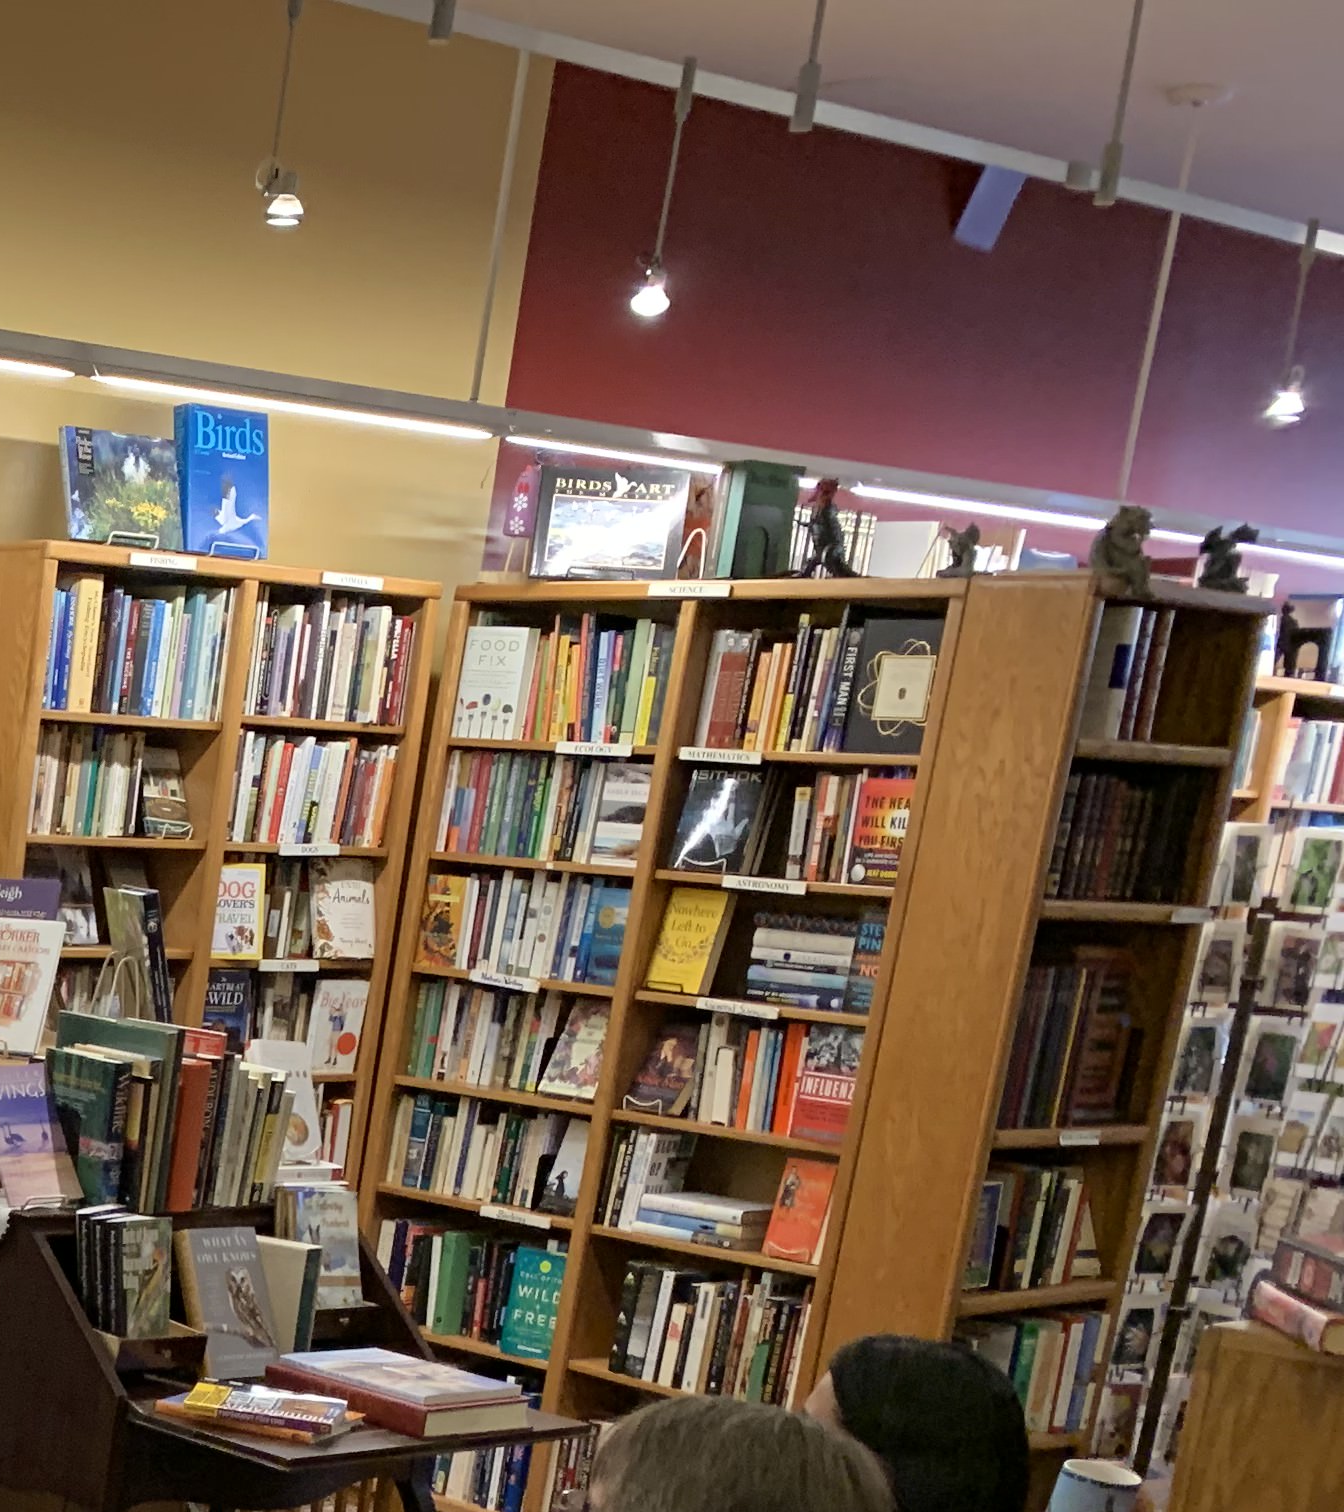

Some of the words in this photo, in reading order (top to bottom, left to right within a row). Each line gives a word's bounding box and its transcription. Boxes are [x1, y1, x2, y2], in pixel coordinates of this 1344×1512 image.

[194, 411, 265, 457] Birds
[554, 477, 612, 493] BIRDS
[635, 482, 675, 497] ART
[469, 639, 520, 652] FOOD
[477, 655, 507, 667] FIX
[843, 647, 858, 677] FIRST
[836, 681, 851, 706] MAN
[574, 744, 612, 754] ECOLOGY
[687, 750, 751, 762] MATHEMATICS
[865, 796, 883, 809] THE
[886, 797, 911, 810] HEA
[861, 815, 883, 828] WILL
[886, 815, 907, 828] KIL
[881, 835, 905, 847] FIRS
[736, 880, 792, 891] ASTRONOMY
[671, 920, 693, 933] Left
[801, 1076, 856, 1100] INFLUENZ
[517, 1285, 562, 1305] WILD
[513, 1308, 558, 1330] FREE
